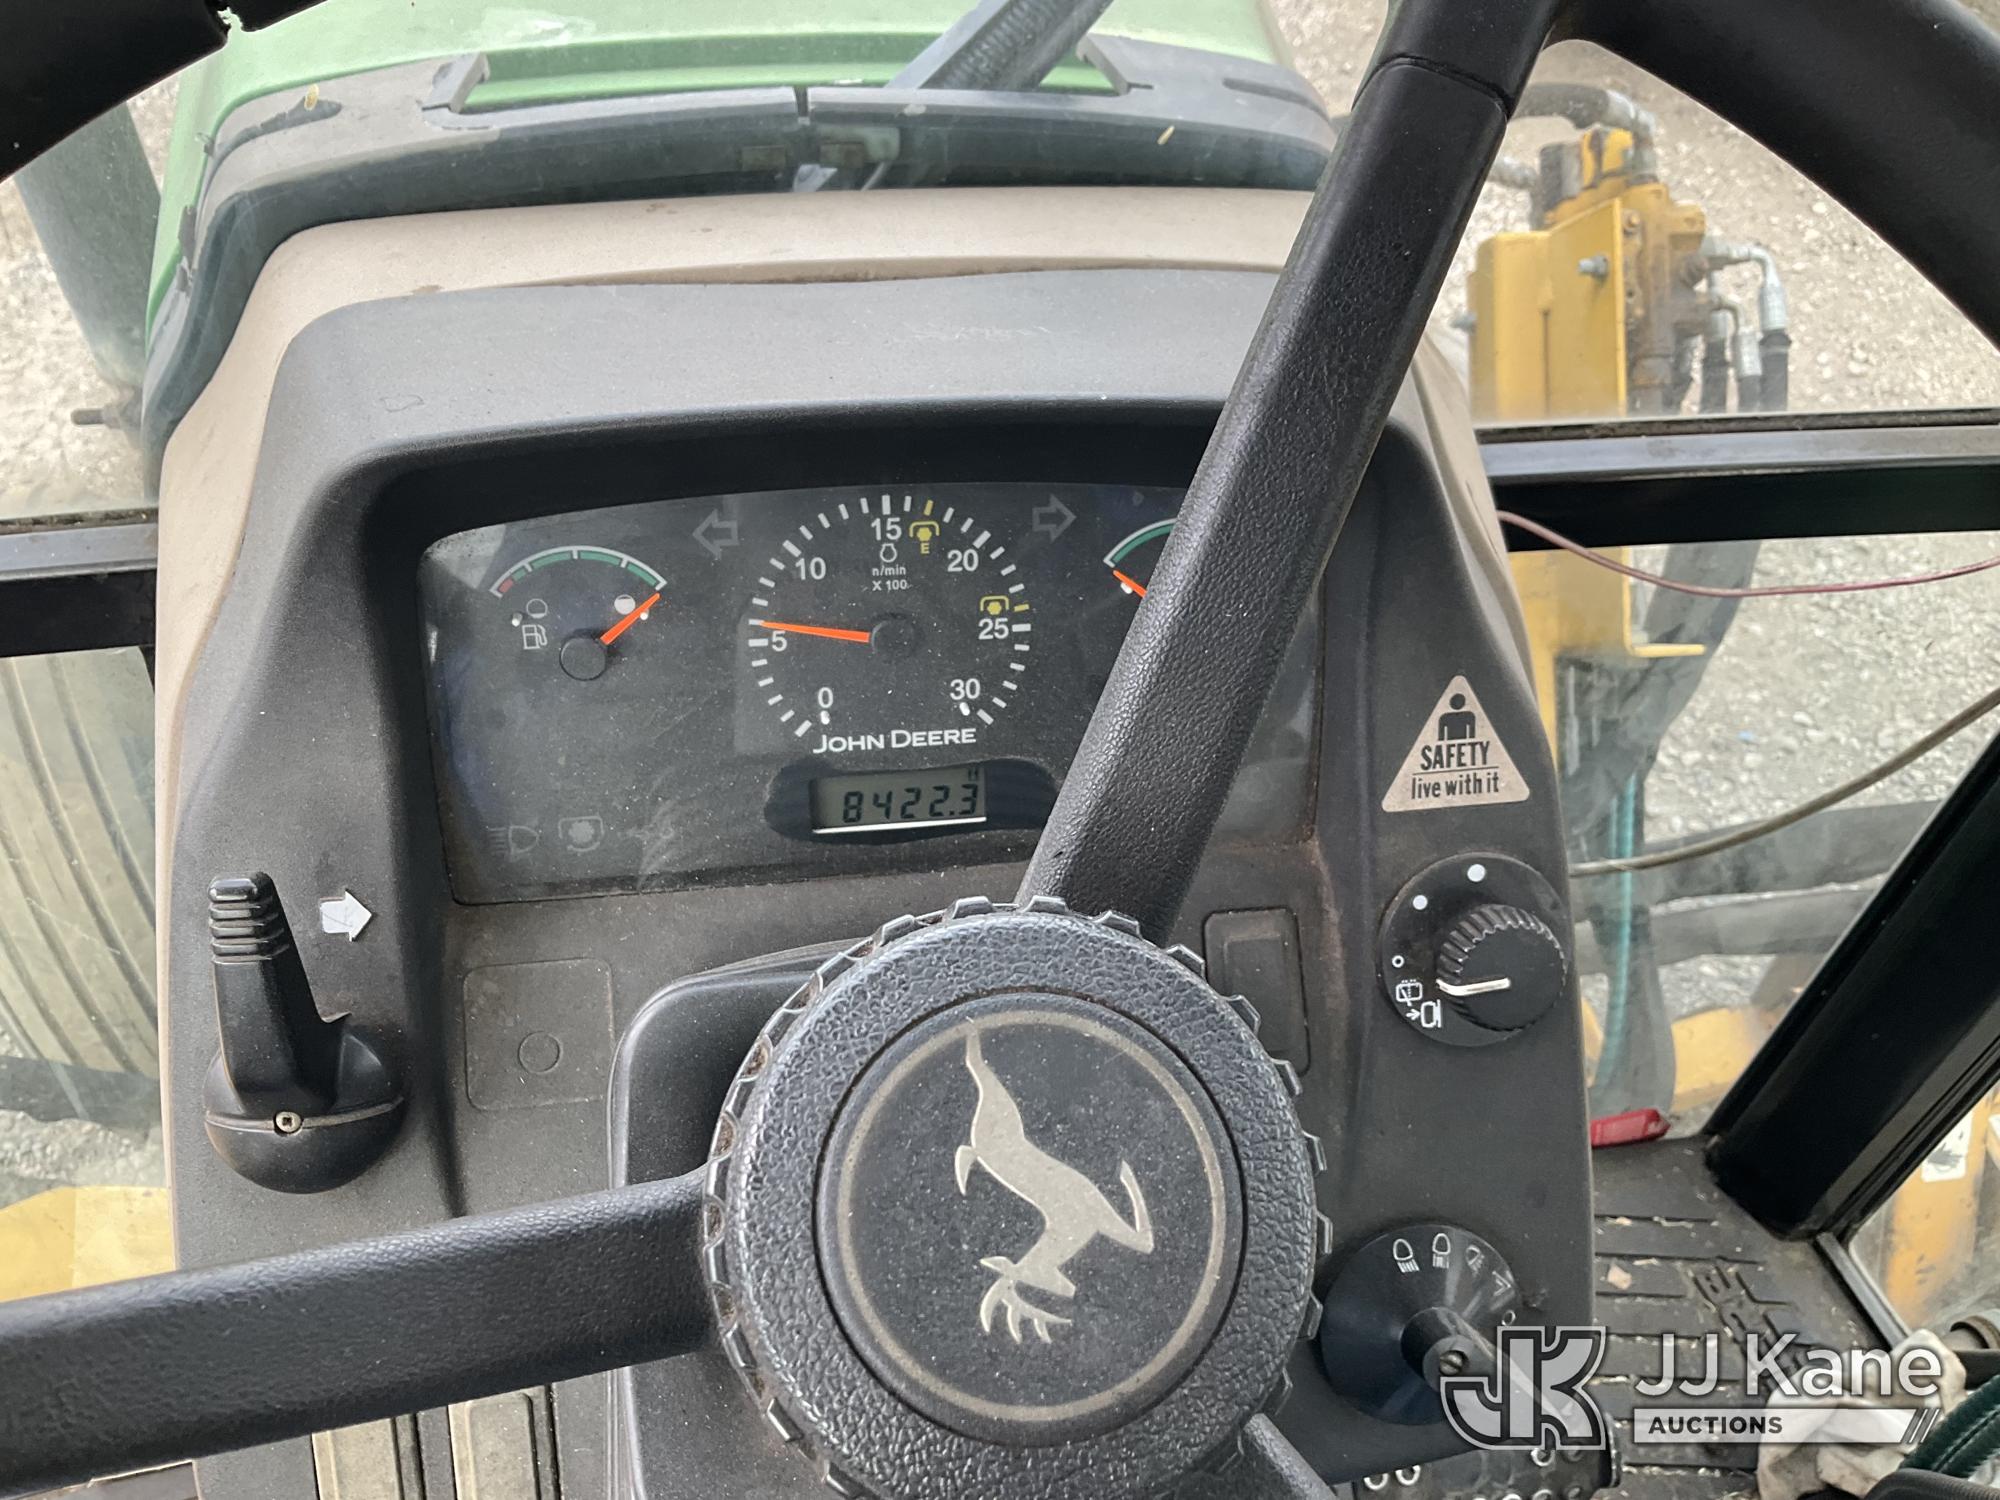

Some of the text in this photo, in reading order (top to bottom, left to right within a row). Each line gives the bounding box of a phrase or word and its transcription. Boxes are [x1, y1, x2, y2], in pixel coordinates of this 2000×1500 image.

[871, 517, 902, 540] 15
[920, 543, 930, 555] E
[796, 557, 827, 580] 10
[872, 563, 907, 576] n/min
[947, 550, 978, 572] 20
[886, 579, 908, 591] 100
[978, 618, 1009, 640] 25
[771, 631, 788, 651] 5
[817, 687, 834, 708] 0
[950, 678, 981, 700] 30
[813, 728, 977, 754] JOHN DEERE
[1420, 741, 1490, 771] SAFETY
[1411, 771, 1500, 799] live with it
[842, 783, 979, 823] 8422.3
